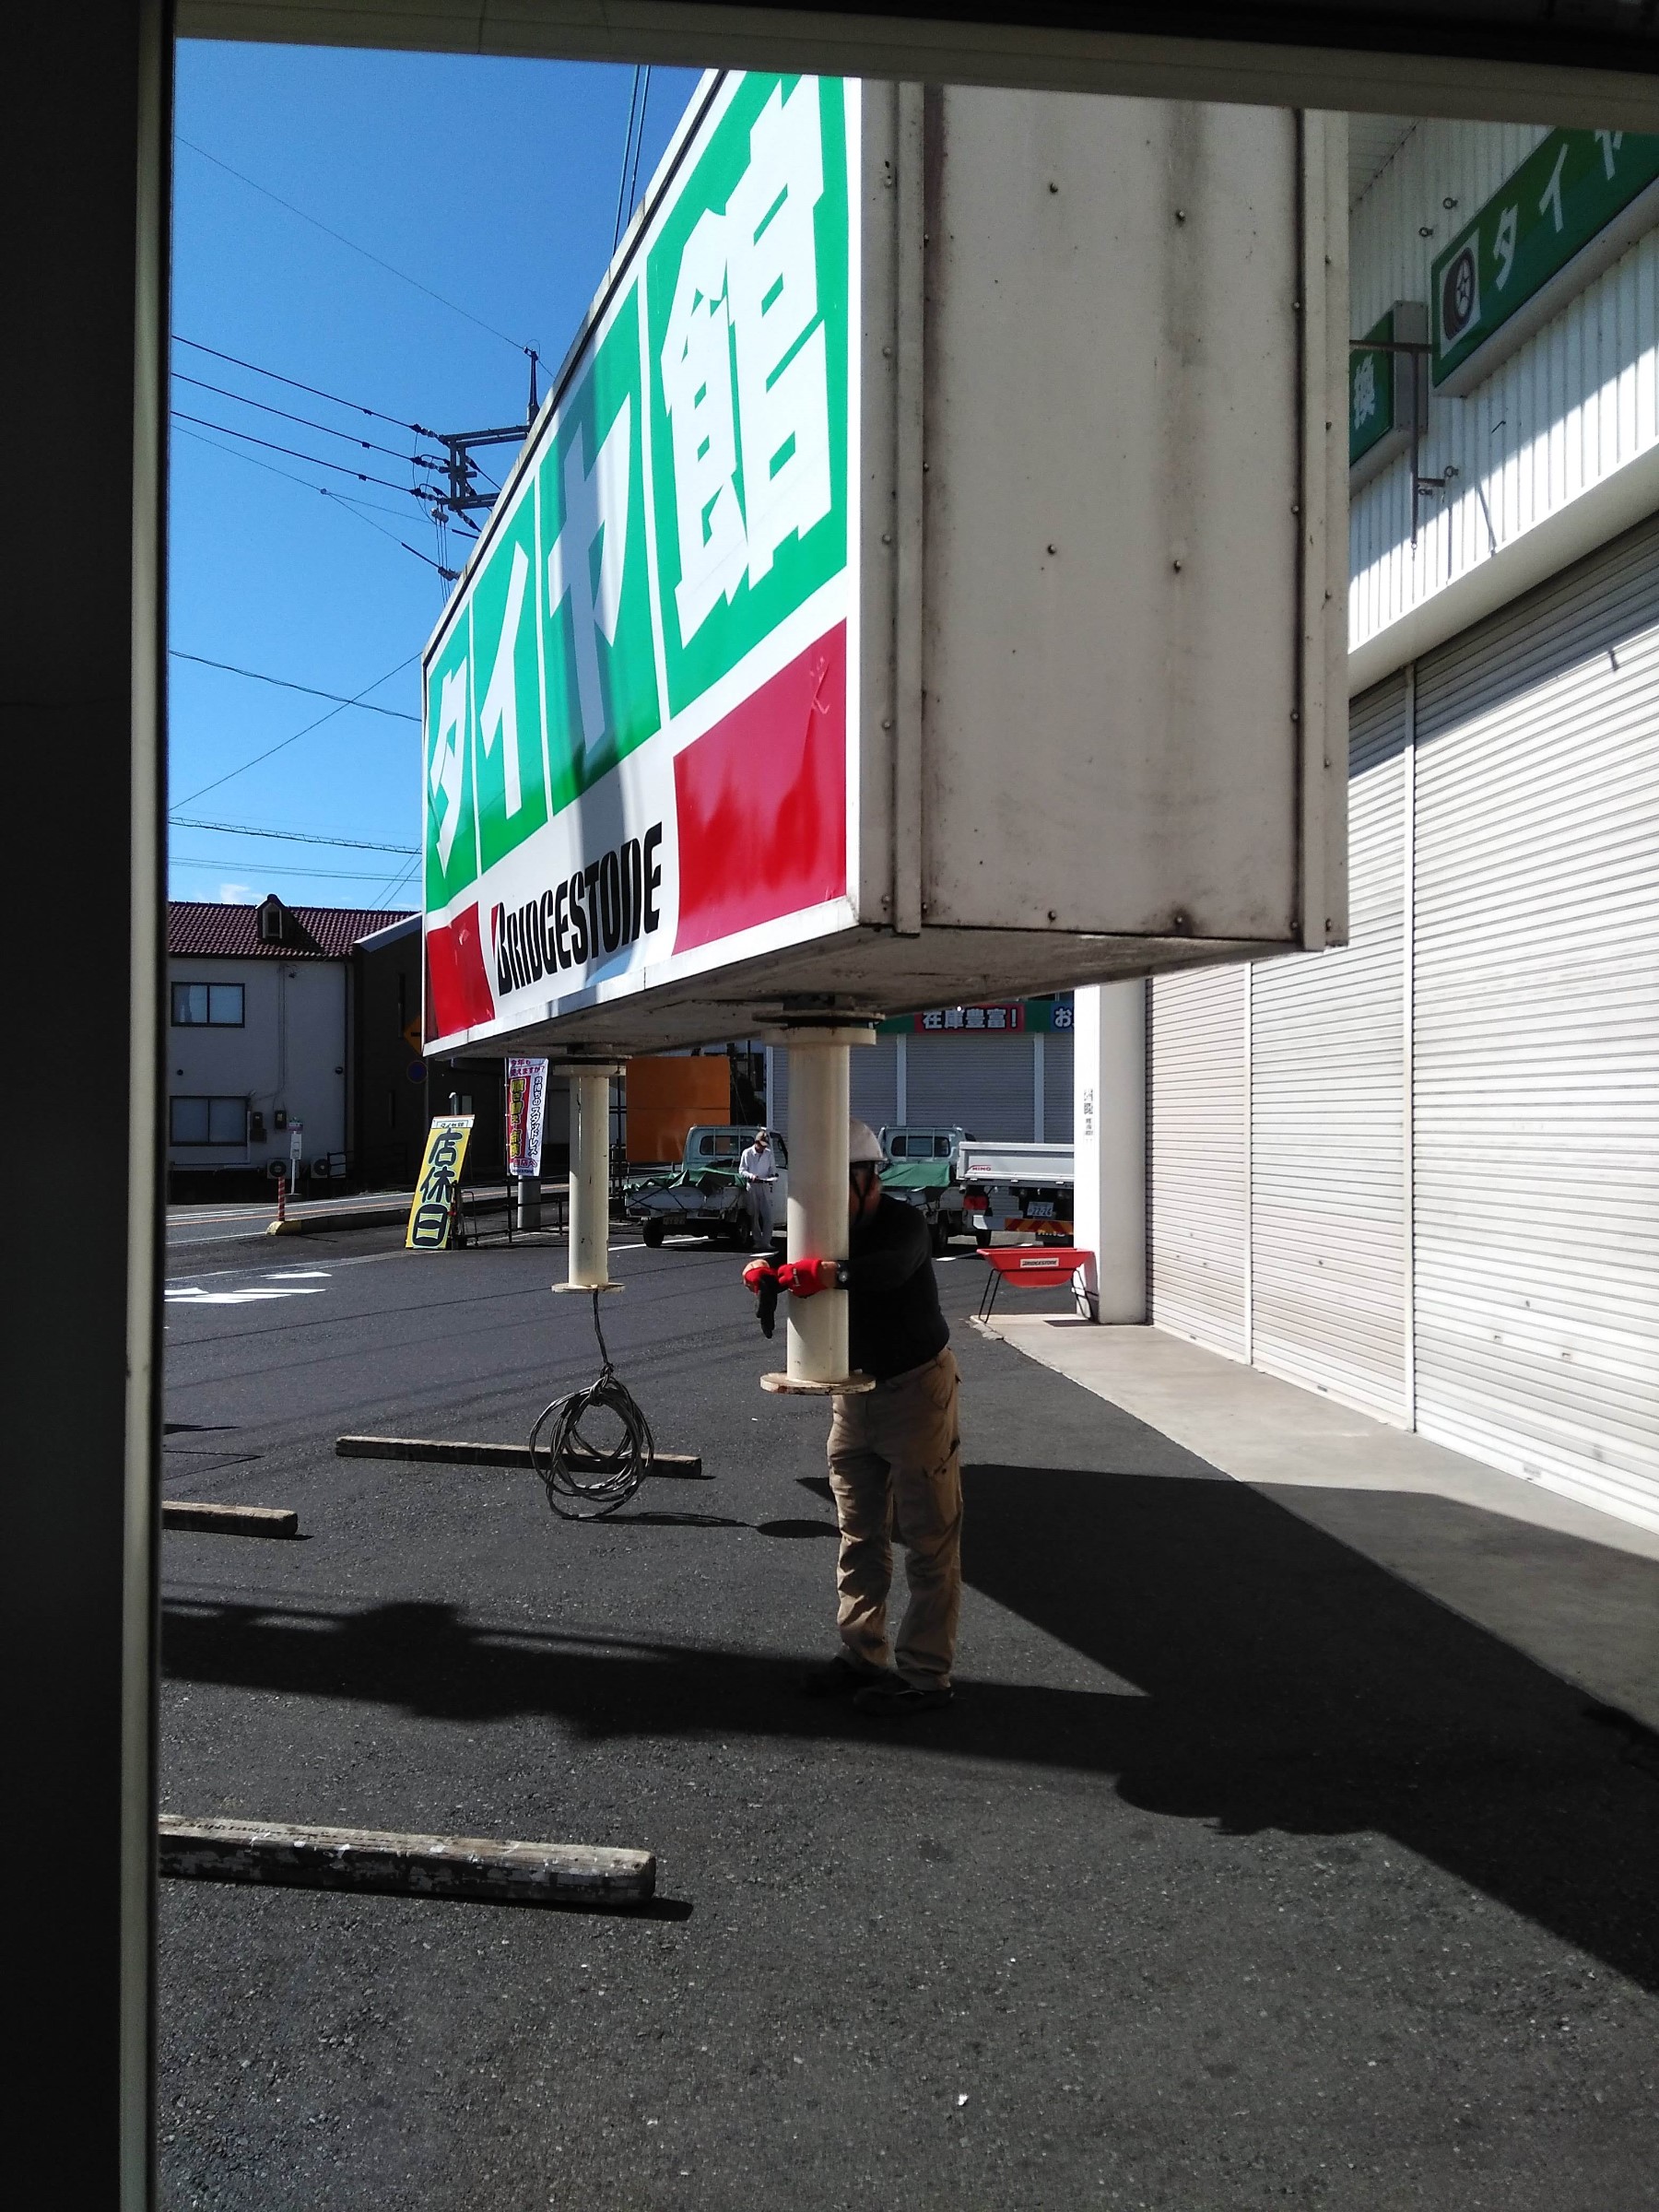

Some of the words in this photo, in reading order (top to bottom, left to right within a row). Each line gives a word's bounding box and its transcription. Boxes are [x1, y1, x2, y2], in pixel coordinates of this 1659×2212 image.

[429, 74, 831, 878] タイヤ館
[491, 821, 663, 997] BRIDGESTONE
[412, 1127, 464, 1247] 店休日
